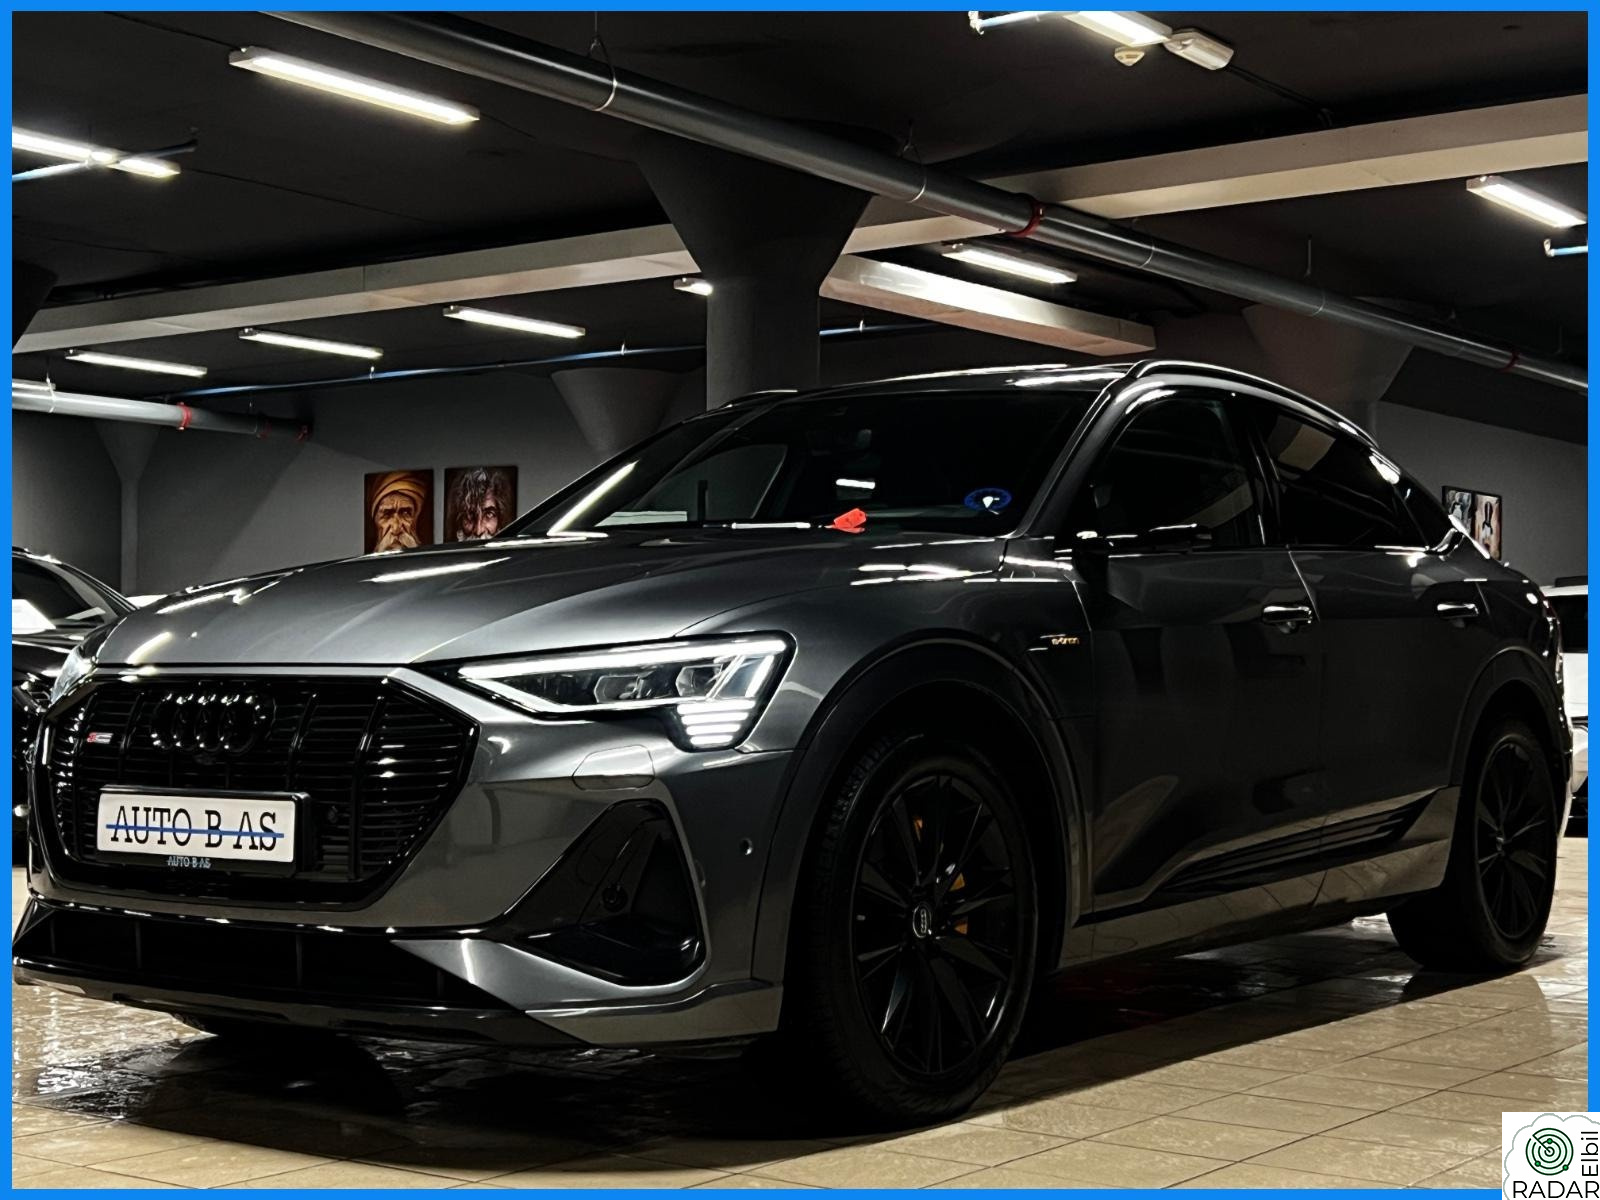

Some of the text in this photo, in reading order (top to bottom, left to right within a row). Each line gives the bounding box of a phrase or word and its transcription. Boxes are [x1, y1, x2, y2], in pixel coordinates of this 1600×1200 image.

[110, 805, 277, 852] AUTO B AS
[167, 856, 190, 867] AUTO
